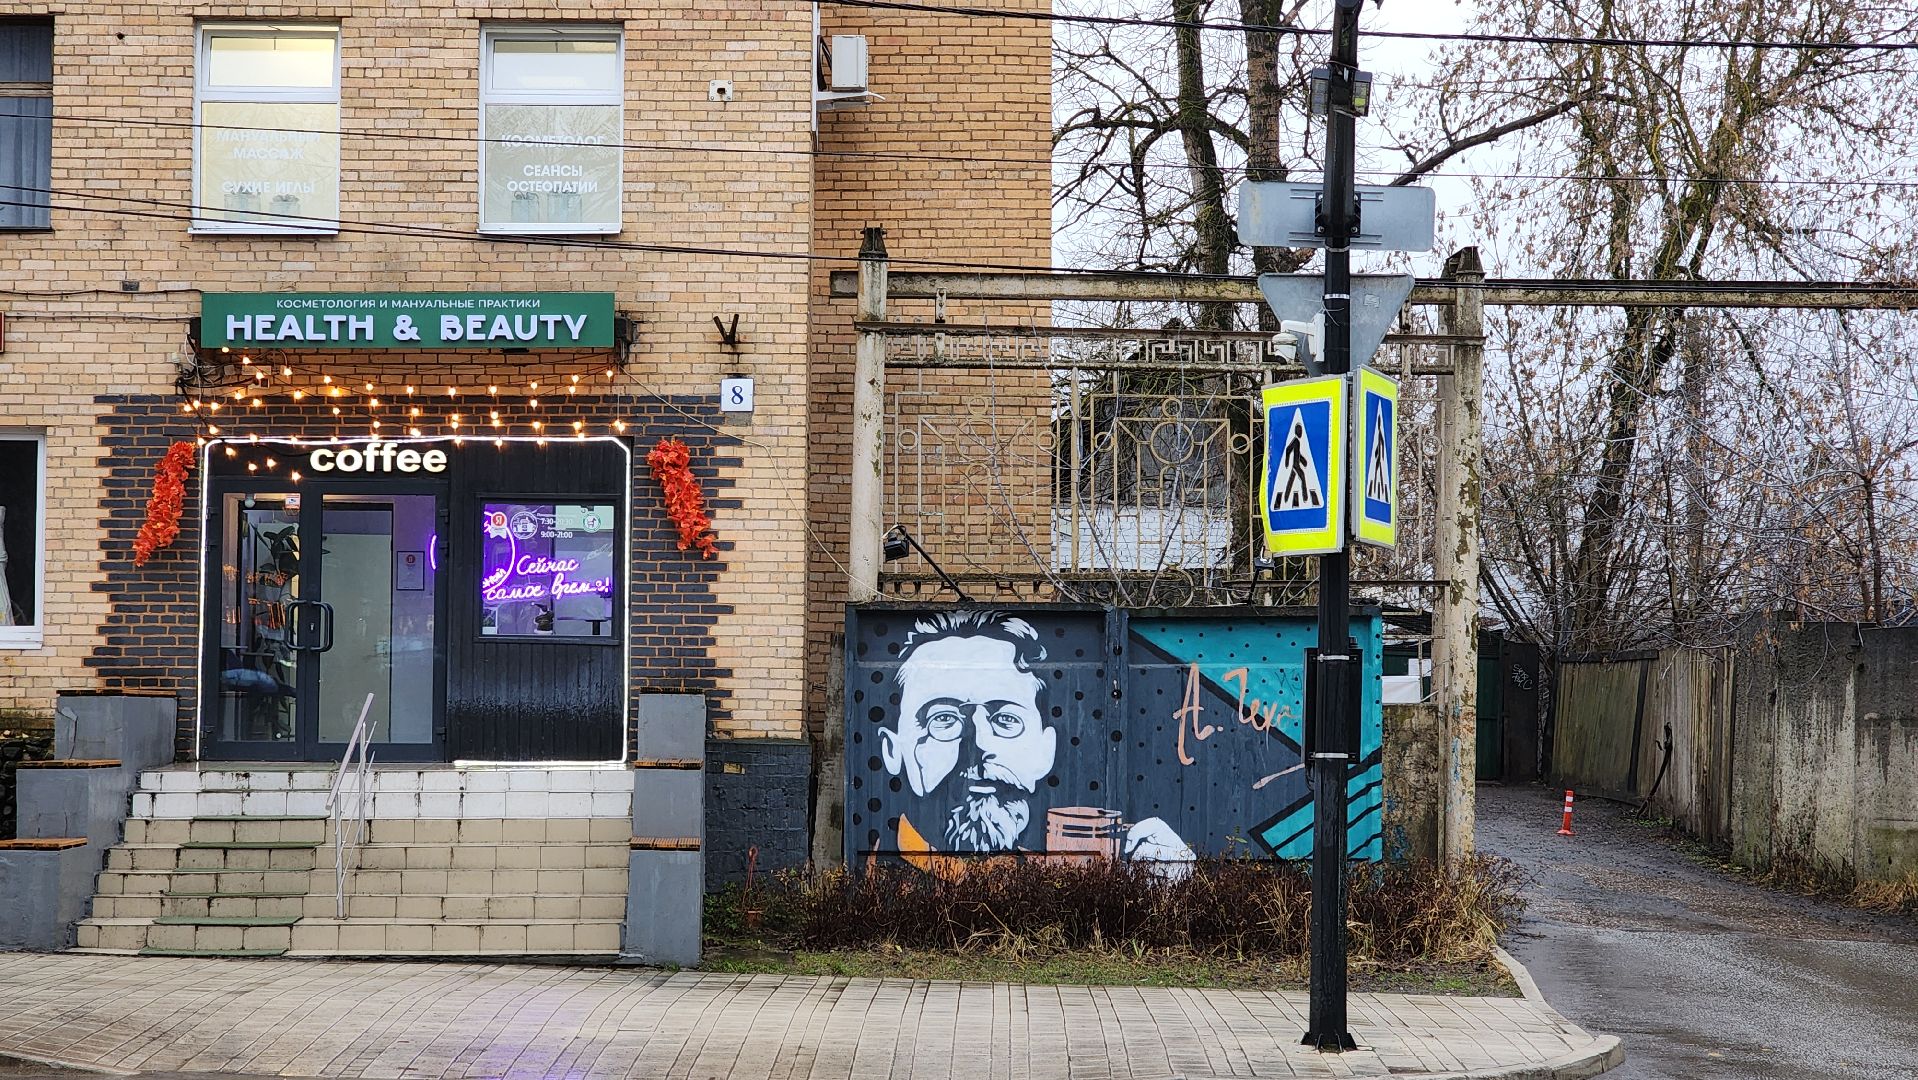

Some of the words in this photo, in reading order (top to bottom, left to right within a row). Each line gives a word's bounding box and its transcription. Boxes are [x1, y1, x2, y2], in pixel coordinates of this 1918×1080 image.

[501, 135, 606, 148] КОСМЕТОЛОГ
[233, 147, 305, 159] МАССАЖ
[523, 165, 583, 177] СЕАНСЫ
[222, 181, 271, 193] СУХИЕ
[276, 181, 315, 193] ИГЛЫ
[506, 181, 598, 193] ОСТЕОПАТИИ
[277, 299, 375, 309] КОСМЕТОЛОГИЯ
[380, 299, 388, 309] И
[391, 299, 475, 309] МАНУАЛЬНЫЕ
[478, 299, 541, 309] ПРАКТИКИ
[226, 314, 374, 341] HEALTH
[392, 314, 421, 341] &
[440, 314, 588, 341] BEAUTY
[731, 385, 744, 405] 8
[310, 442, 448, 473] coffee
[540, 530, 573, 539] 9:00-21:00
[516, 554, 580, 576] Сейчас
[486, 584, 545, 601] самое
[1172, 662, 1224, 766] А.
